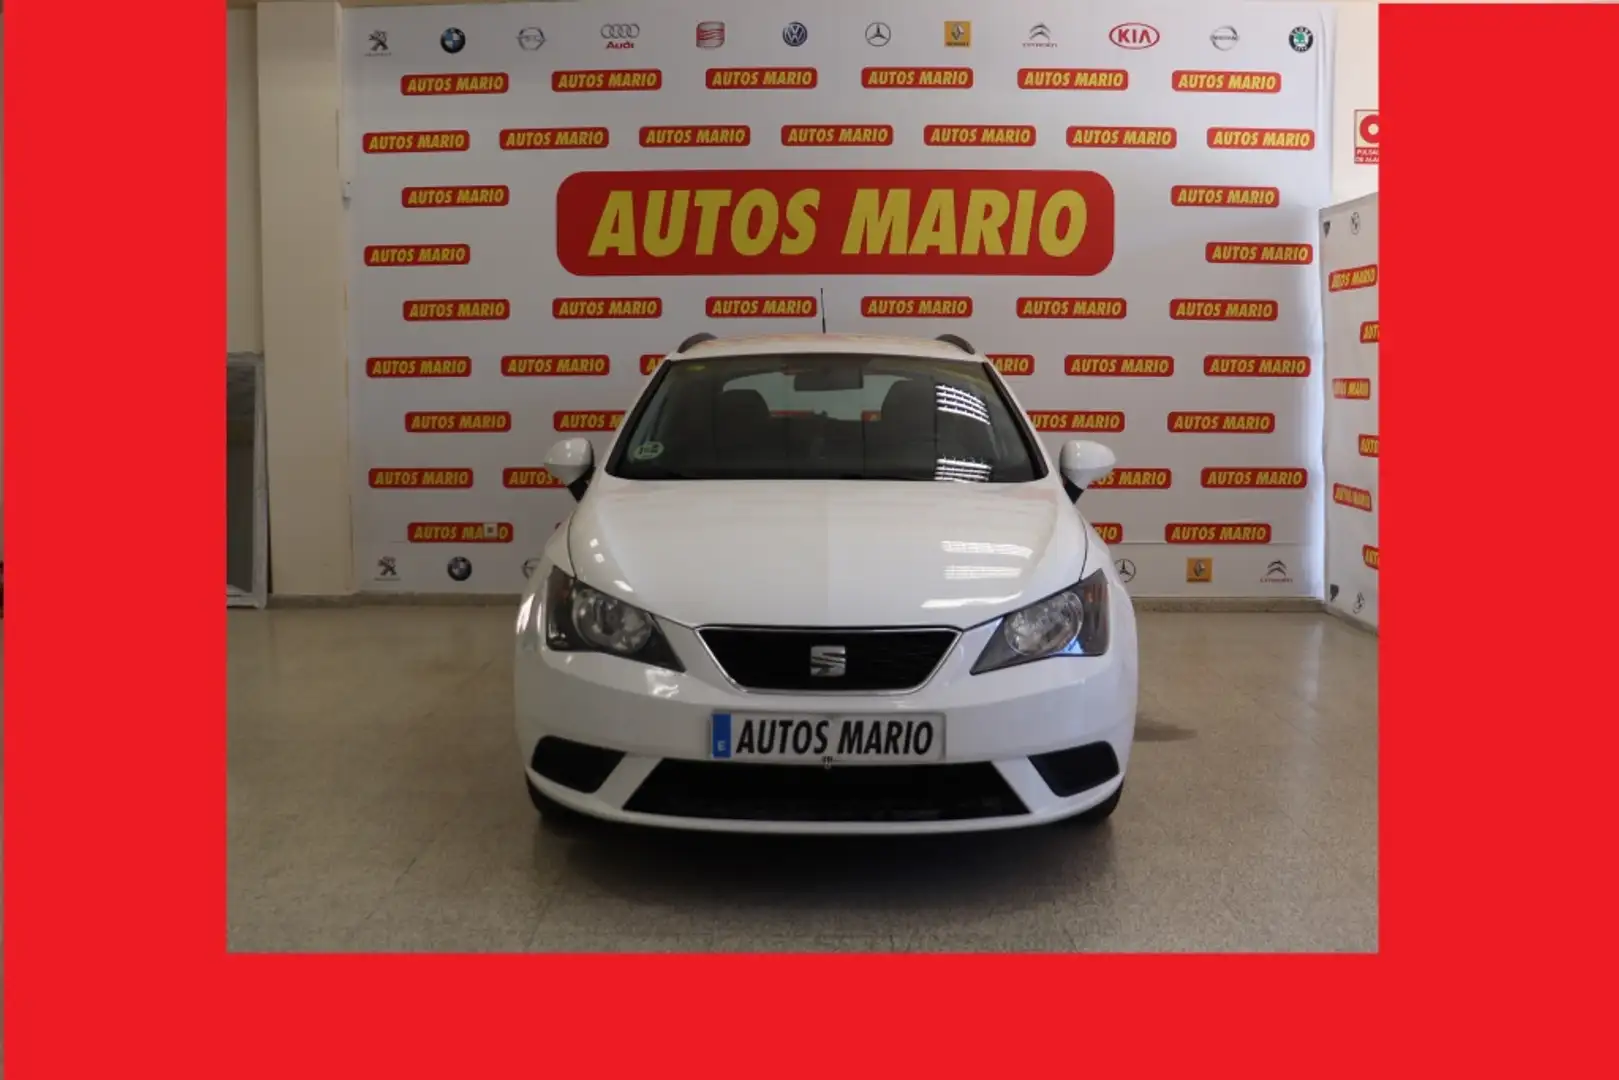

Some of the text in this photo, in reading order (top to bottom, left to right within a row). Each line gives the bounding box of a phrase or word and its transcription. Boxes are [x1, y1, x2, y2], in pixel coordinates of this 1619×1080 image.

[1118, 28, 1151, 44] KIA
[606, 39, 635, 50] Audi
[408, 75, 504, 92] AUTOS MARIO
[558, 72, 657, 89] AUTOS MARIO
[712, 71, 813, 86] AUTOS MARIO
[868, 70, 970, 86] AUTOS MARIO
[1024, 71, 1123, 87] AUTOS MARIO
[1180, 74, 1276, 90] AUTOS MARIO
[368, 133, 465, 150] AUTOS MARIO
[506, 130, 604, 147] AUTOS MARIO
[646, 128, 745, 145] AUTOS MARIO
[789, 127, 889, 144] AUTOS MARIO
[932, 128, 1031, 145] AUTOS MARIO
[1074, 130, 1171, 146] AUTOS MARIO
[1214, 131, 1310, 147] AUTOS MARIO
[408, 188, 504, 205] AUTOS MARIO
[1177, 188, 1275, 205] AUTOS MARIO
[590, 188, 1088, 258] AUTOS MARIO
[372, 247, 465, 264] AUTOS MARIO
[1212, 245, 1309, 261] AUTOS MARIO
[409, 303, 505, 319] AUTOS MARIO
[559, 300, 657, 317] AUTOS MARIO
[713, 300, 812, 315] AUTOS MARIO
[868, 300, 968, 315] AUTOS MARIO
[1023, 300, 1121, 316] AUTOS MARIO
[1176, 302, 1273, 319] AUTOS MARIO
[373, 359, 466, 376] AUTOS MARIO
[508, 358, 605, 374] AUTOS MARIO
[989, 358, 1030, 373] ARIO
[1071, 358, 1169, 374] AUTOS MARIO
[1211, 358, 1306, 375] AUTOS MARIO
[411, 414, 506, 430] AUTOS MARIO
[561, 414, 605, 429] AUTOS
[1029, 414, 1120, 430] UTOS MARIO
[1175, 415, 1269, 431] AUTOS MARIO
[375, 471, 468, 487] AUTOS MARIO
[1119, 471, 1168, 487] MARIO
[1206, 471, 1303, 487] AUTOS MARIO
[414, 526, 509, 541] AUTOS MAO
[1169, 525, 1266, 541] AUTOS MARIO
[736, 719, 933, 755] AUTOS MARIO
